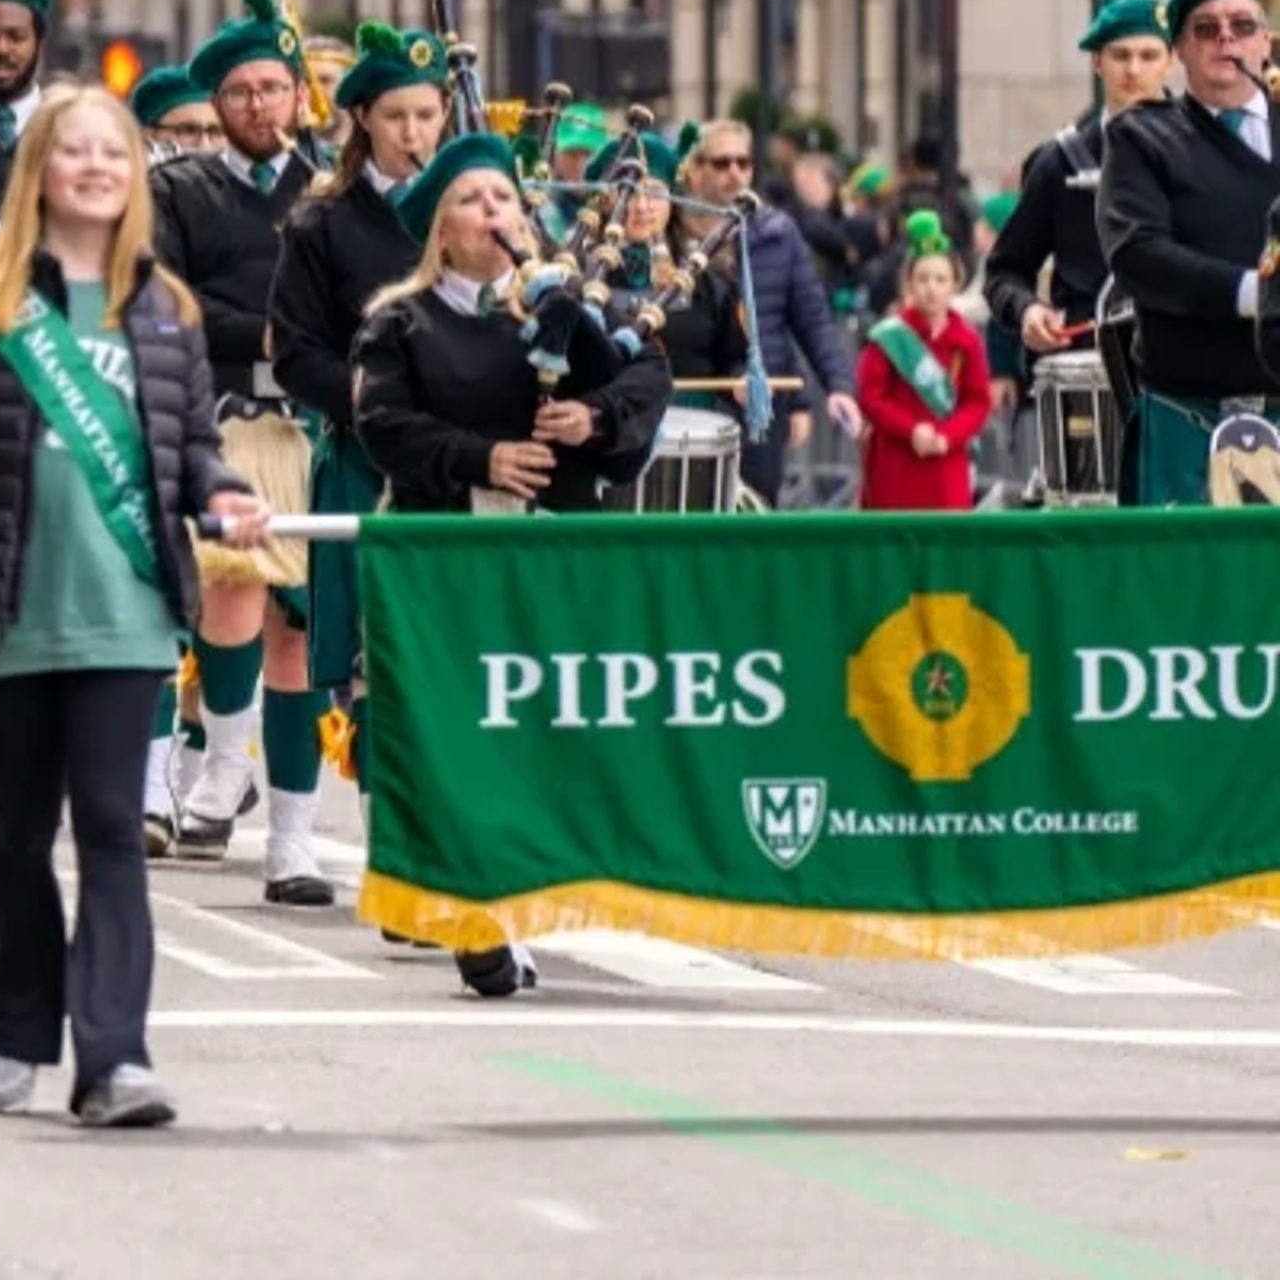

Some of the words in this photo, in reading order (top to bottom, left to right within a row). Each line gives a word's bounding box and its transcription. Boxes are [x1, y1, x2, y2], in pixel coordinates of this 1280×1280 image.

[22, 328, 130, 486] MANHATTAN
[479, 650, 785, 728] PIPES
[1072, 644, 1280, 721] DRU
[829, 810, 1006, 836] MANHATTAN
[1013, 807, 1138, 833] COLLEGE
